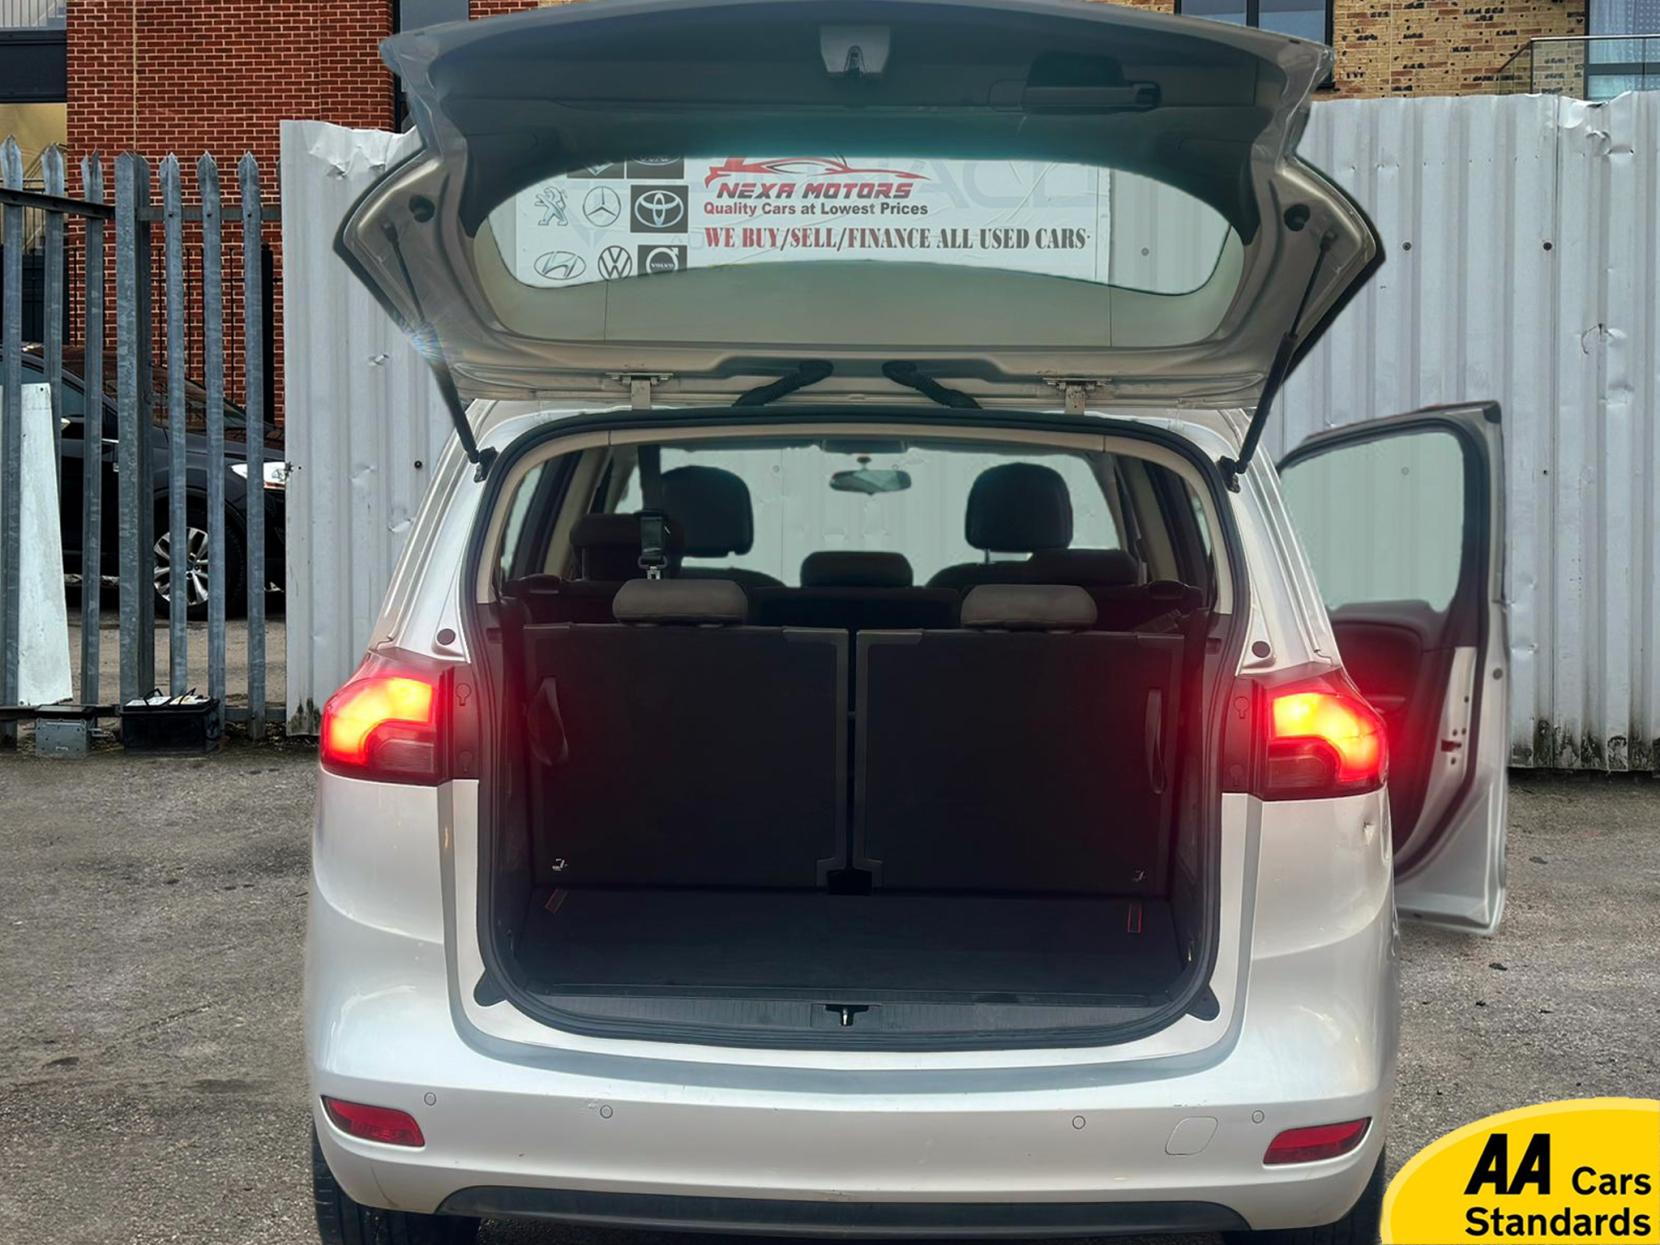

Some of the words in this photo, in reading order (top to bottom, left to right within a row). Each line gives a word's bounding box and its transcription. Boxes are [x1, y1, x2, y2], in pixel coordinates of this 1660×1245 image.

[716, 182, 794, 199] NEXA
[802, 182, 914, 199] MOTORS
[703, 201, 757, 217] Quality
[762, 202, 796, 216] Cars
[800, 203, 816, 216] at
[820, 202, 876, 216] Lowest
[880, 202, 928, 216] Prices
[704, 227, 735, 248] WE
[936, 228, 973, 250] ALL
[979, 228, 1030, 250] USED
